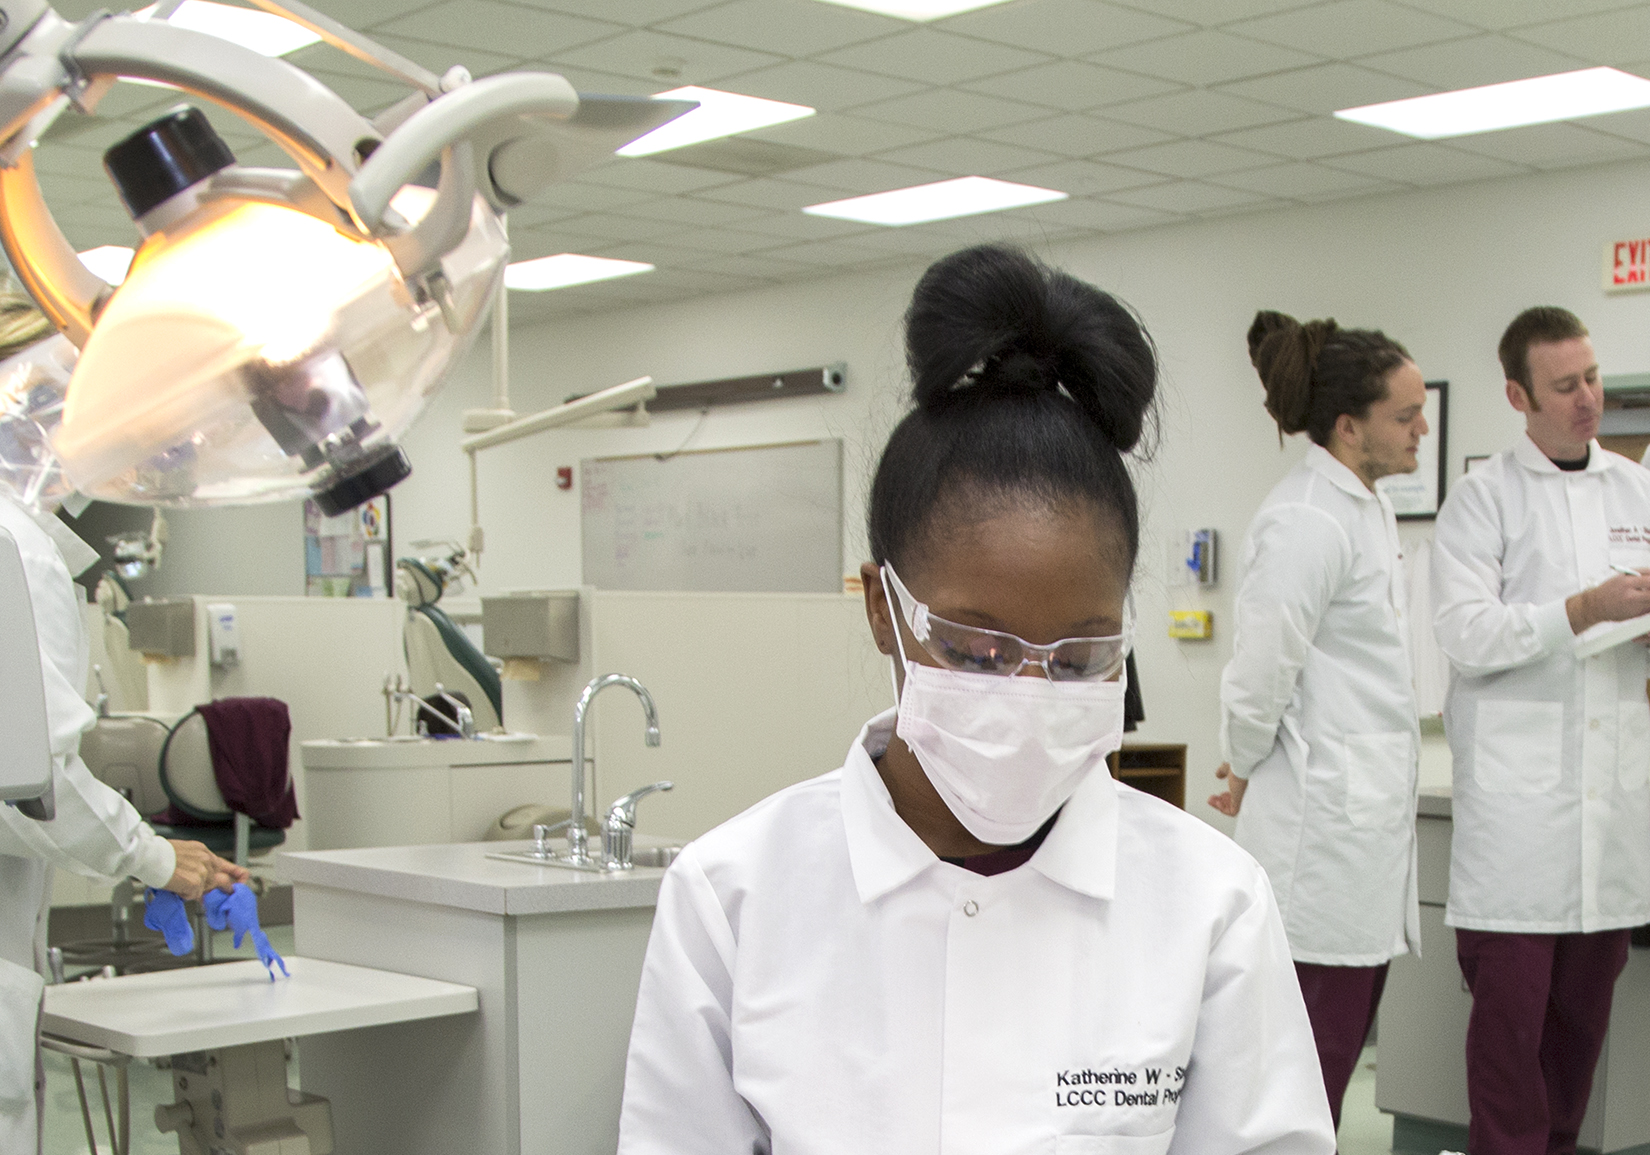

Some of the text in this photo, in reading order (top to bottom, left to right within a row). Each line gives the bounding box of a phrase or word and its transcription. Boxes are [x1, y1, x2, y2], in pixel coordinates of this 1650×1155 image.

[1613, 238, 1650, 285] EXI
[1057, 1068, 1137, 1086] Katherine
[1145, 1068, 1161, 1084] W
[1056, 1090, 1107, 1107] LCCC
[1114, 1089, 1159, 1106] Dental
